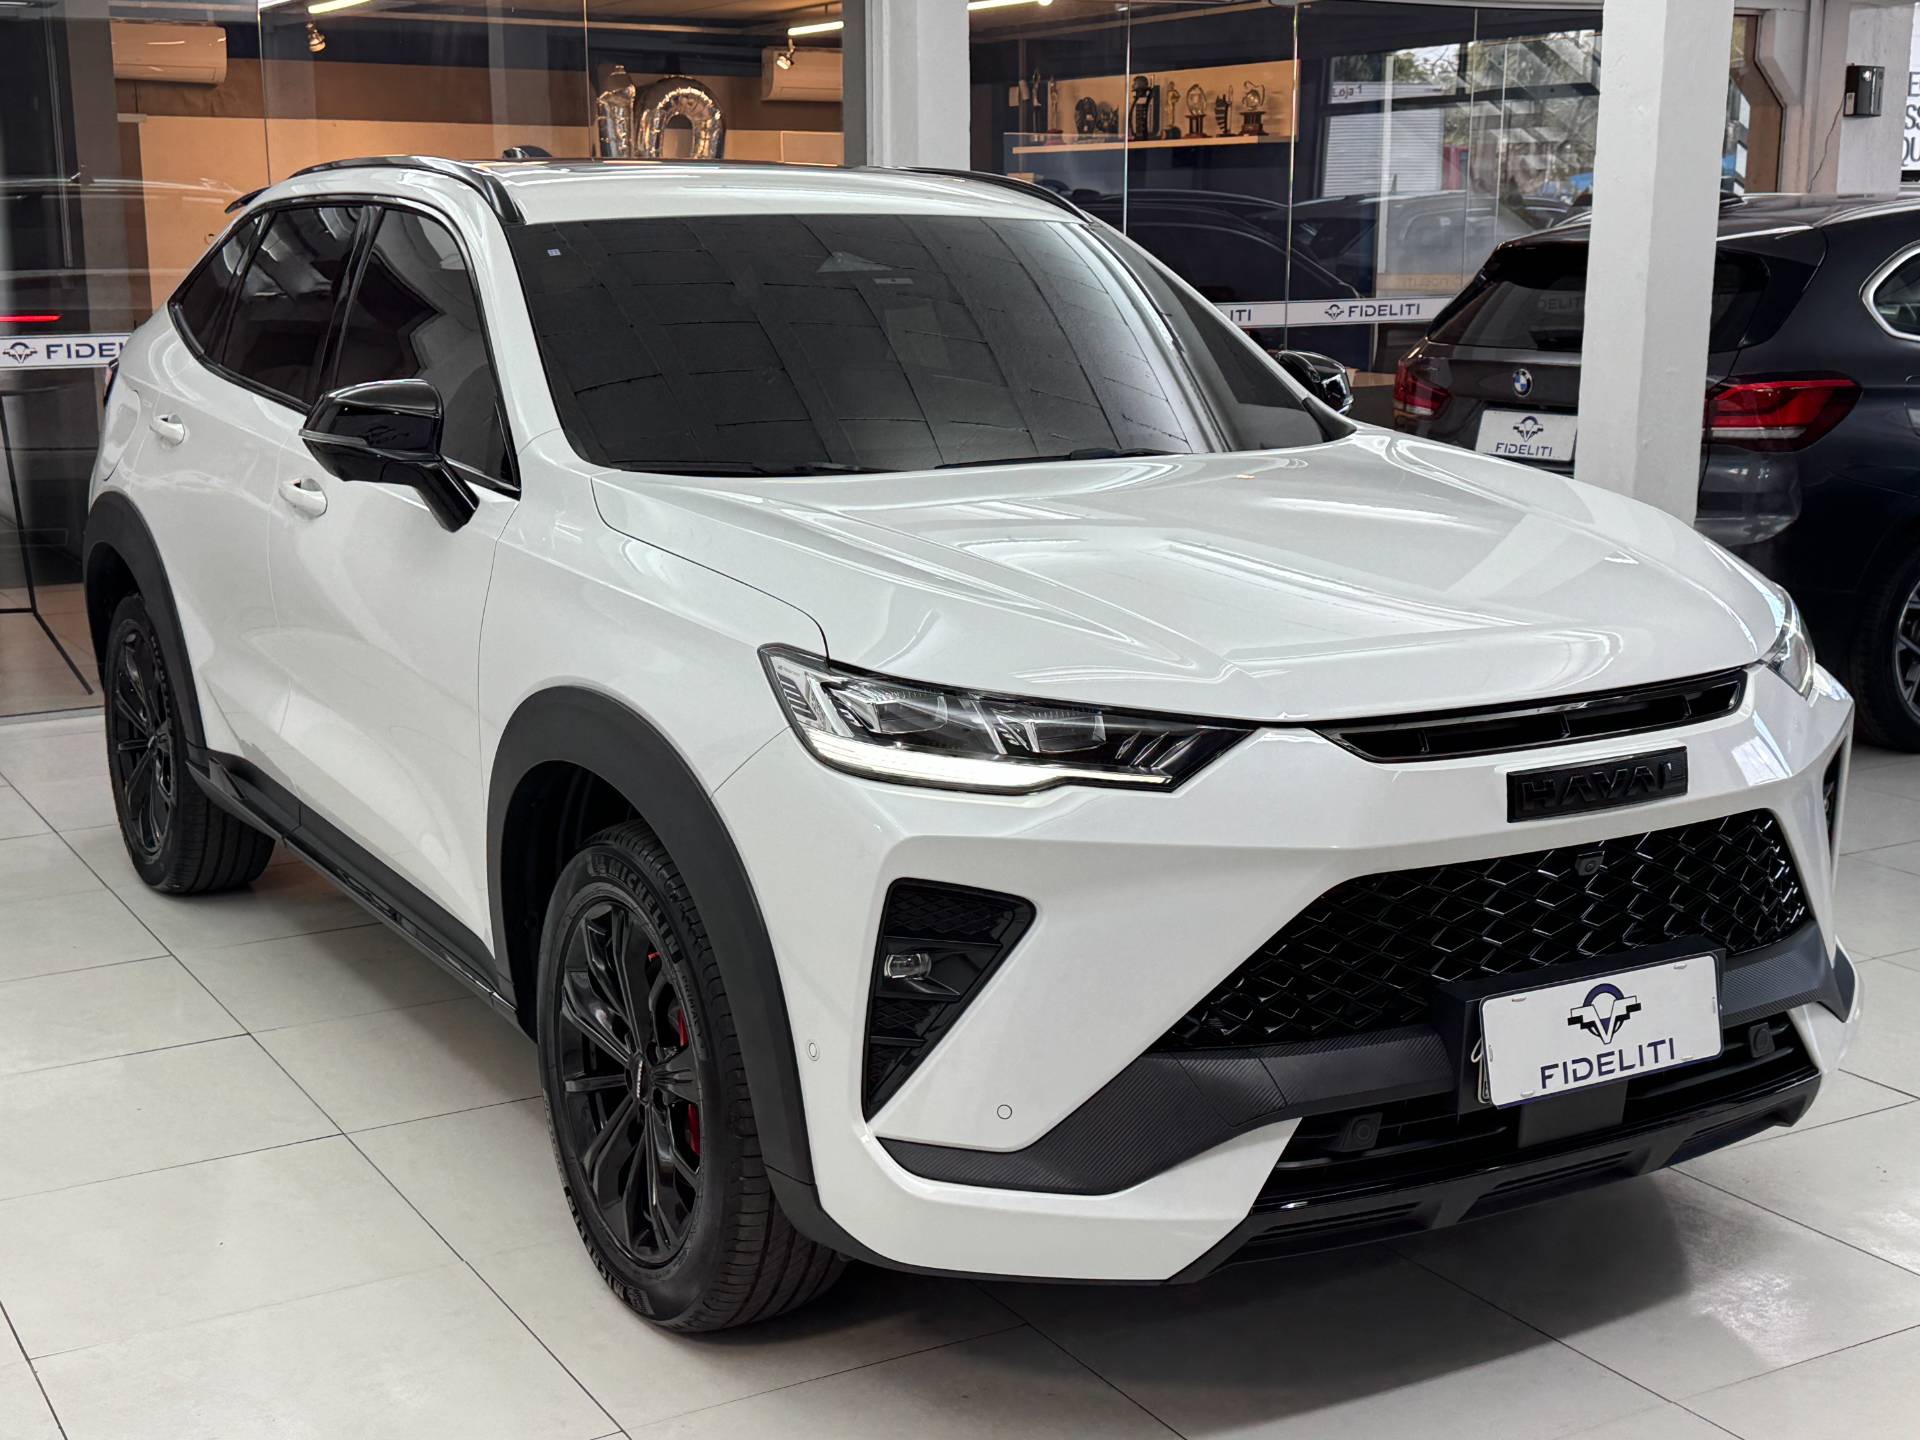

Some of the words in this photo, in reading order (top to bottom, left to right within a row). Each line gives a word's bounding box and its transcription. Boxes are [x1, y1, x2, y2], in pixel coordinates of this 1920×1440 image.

[1333, 86, 1354, 99] Loja
[1348, 303, 1420, 318] FIDELITI
[1495, 442, 1553, 457] FIDELITI
[1521, 761, 1687, 811] HAVAL
[608, 858, 684, 964] MICHELIN
[1540, 1037, 1677, 1090] FIDELITI
